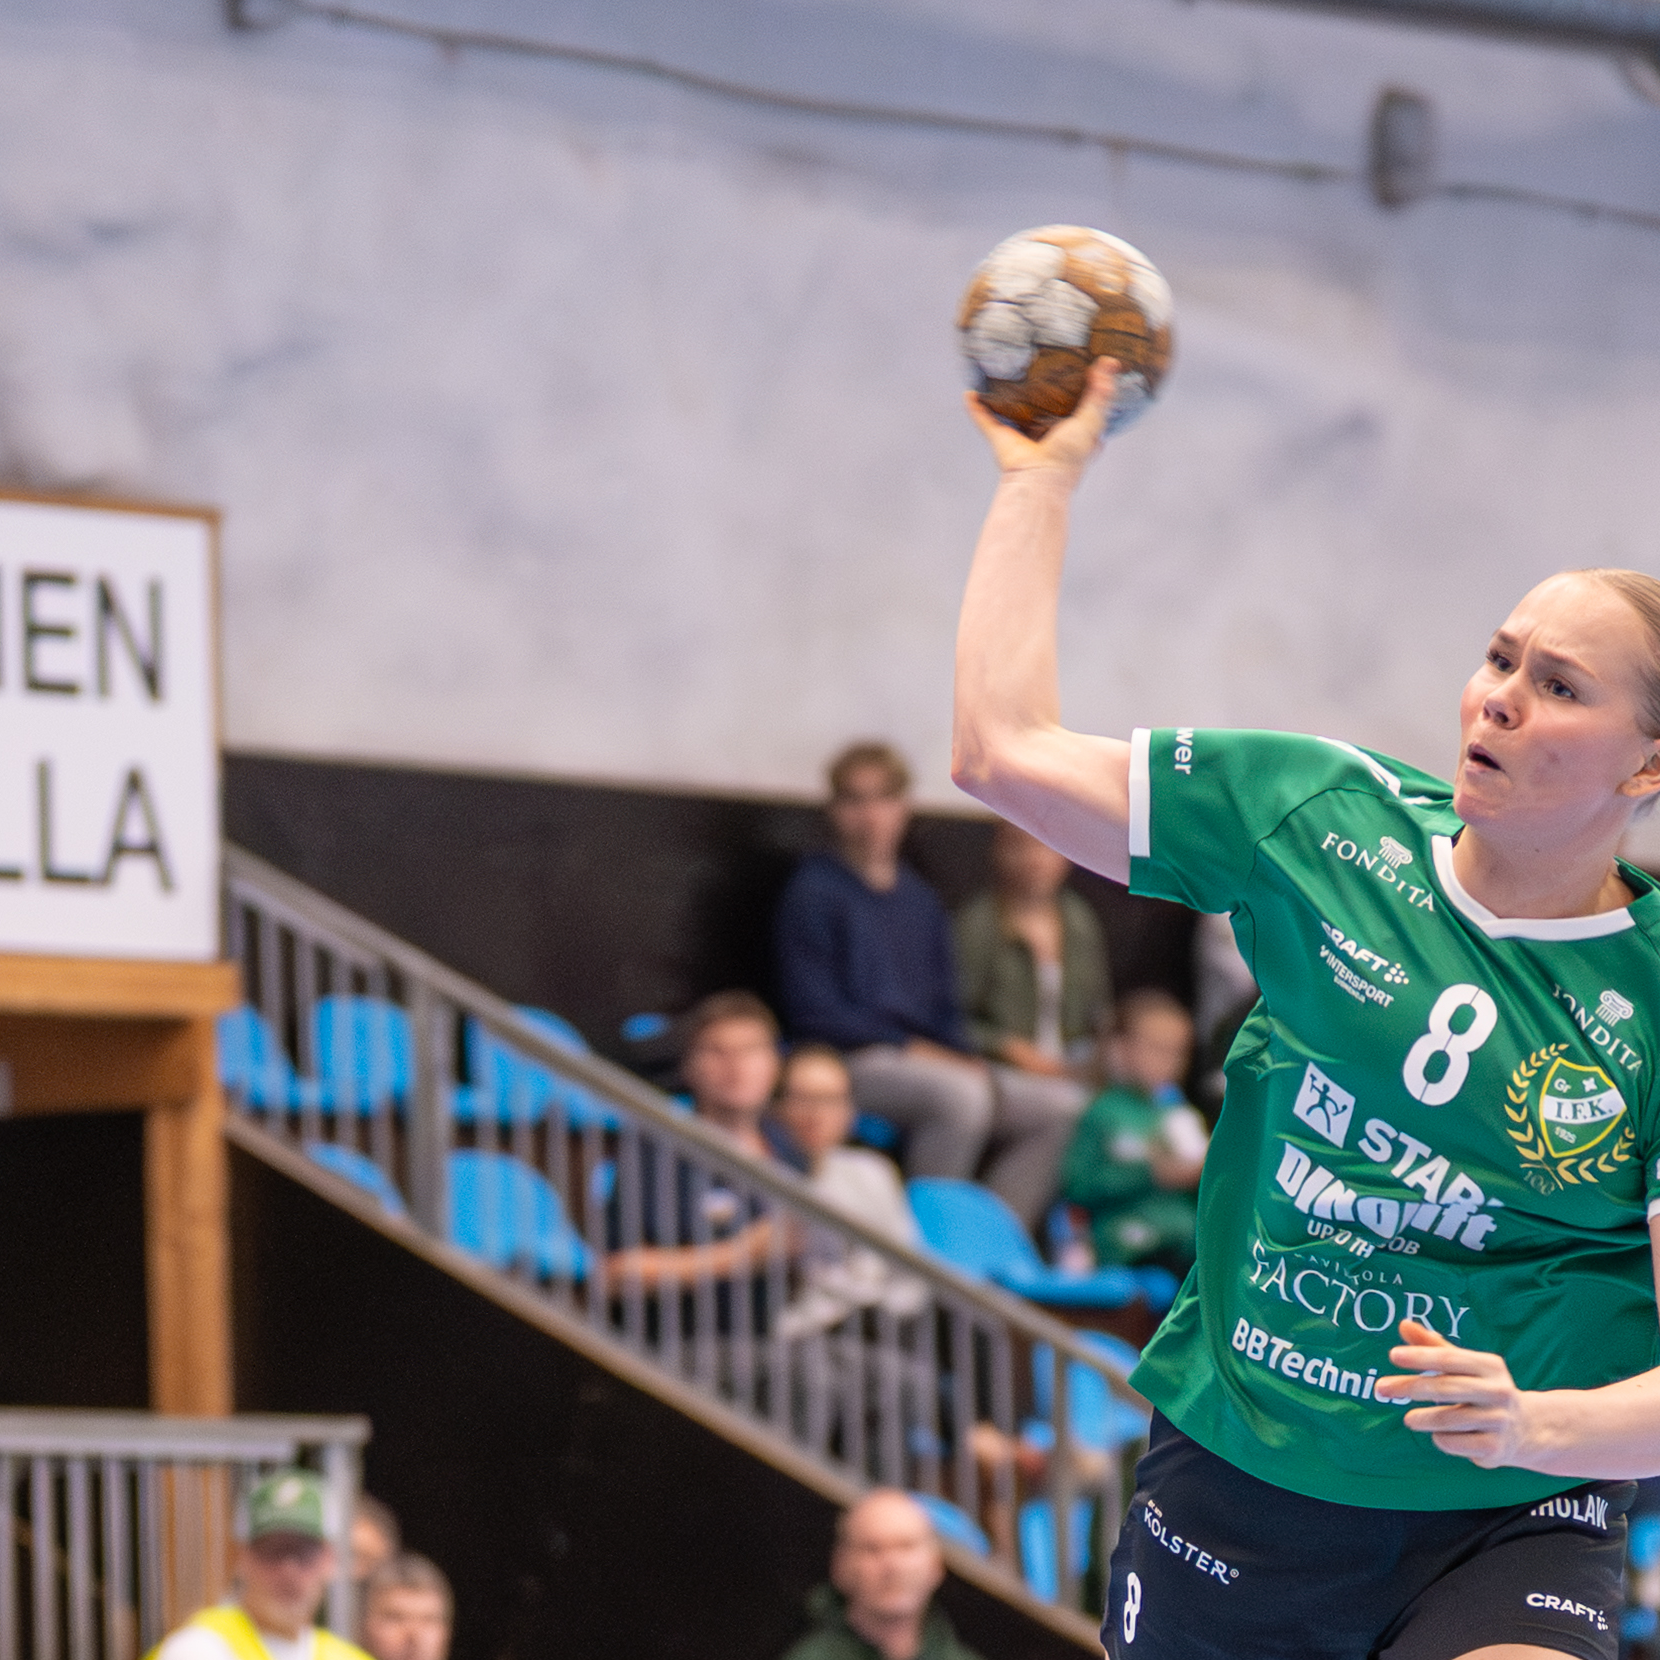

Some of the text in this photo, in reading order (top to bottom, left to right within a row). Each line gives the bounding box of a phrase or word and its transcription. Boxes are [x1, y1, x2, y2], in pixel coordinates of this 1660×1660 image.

[1321, 831, 1437, 913] FONDITA
[1326, 952, 1394, 1008] INTERSPORT
[1403, 983, 1498, 1106] 8
[1554, 1078, 1572, 1093] Gr
[1358, 1118, 1505, 1207] STAR
[1249, 1239, 1470, 1339] FACTORY
[1123, 1572, 1142, 1644] 8
[1526, 1593, 1597, 1622] CRAFT
